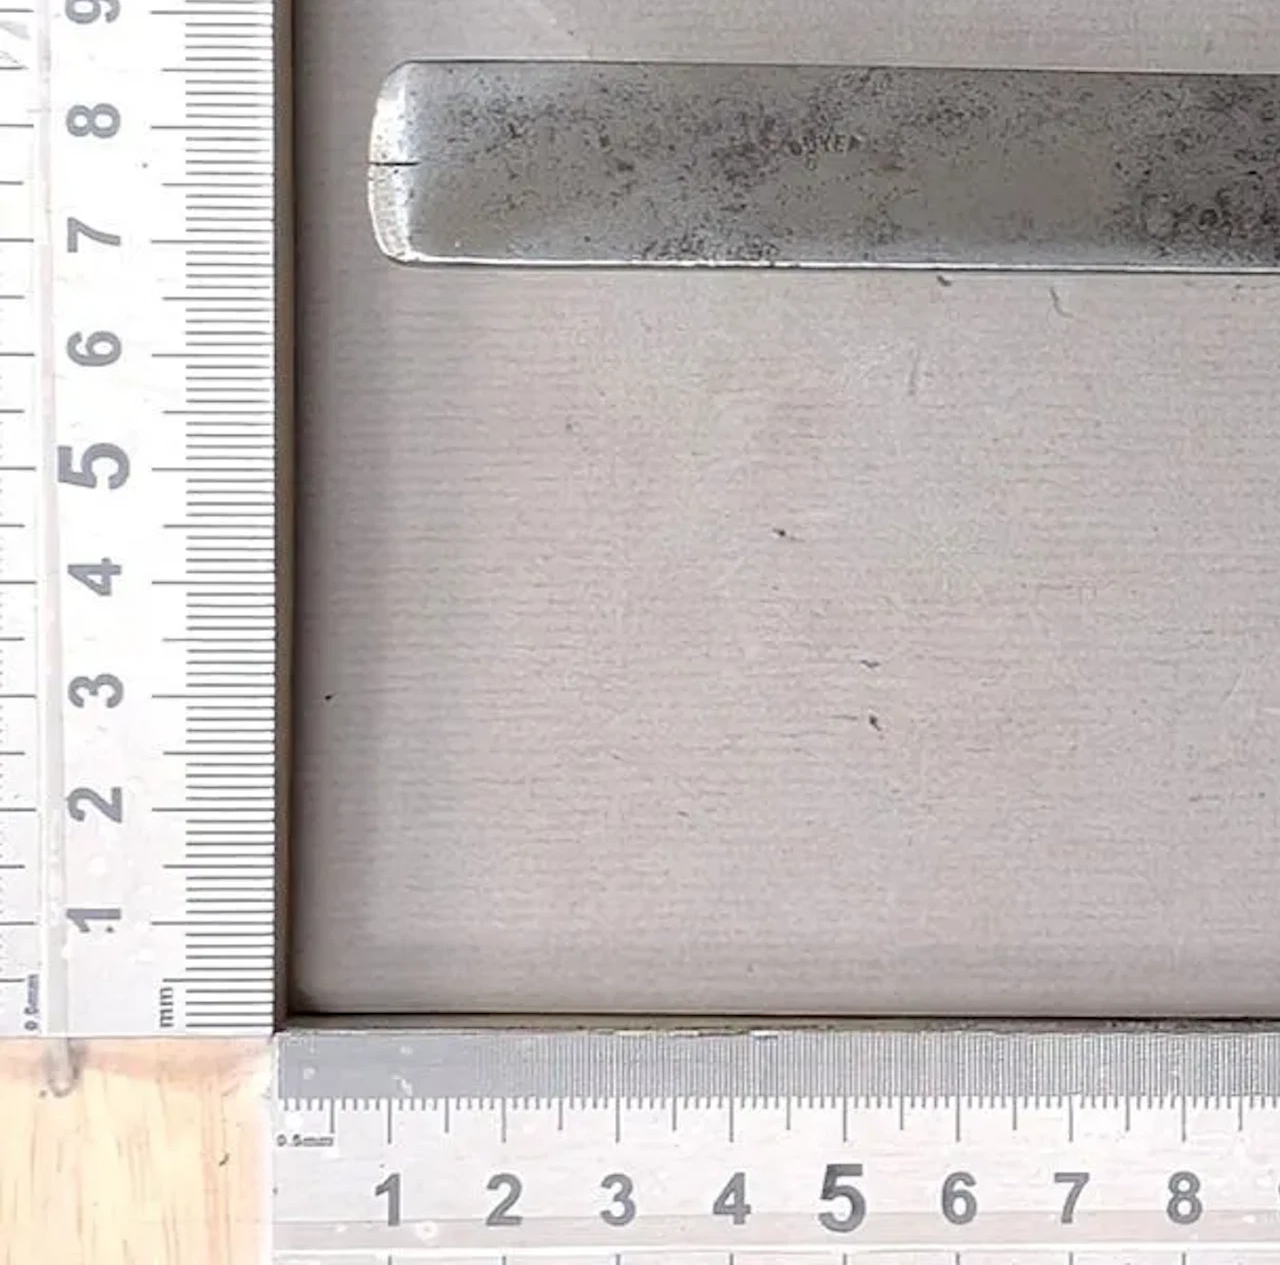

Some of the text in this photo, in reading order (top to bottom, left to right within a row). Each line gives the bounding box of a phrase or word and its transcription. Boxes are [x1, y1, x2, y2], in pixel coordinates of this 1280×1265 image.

[65, 103, 122, 139] 8
[67, 217, 122, 253] 7
[66, 331, 123, 367] 6
[57, 443, 131, 490] 5
[67, 557, 123, 596] 4
[68, 673, 125, 708] 3
[64, 787, 123, 824] 2
[65, 908, 122, 933] 1
[160, 987, 174, 1028] mm
[375, 1173, 400, 1227] 1
[485, 1173, 524, 1227] 2
[600, 1173, 636, 1227] 3
[713, 1172, 751, 1225] 4
[818, 1163, 866, 1233] 5
[941, 1171, 977, 1225] 6
[1054, 1172, 1090, 1224] 7
[1166, 1171, 1203, 1225] 8
